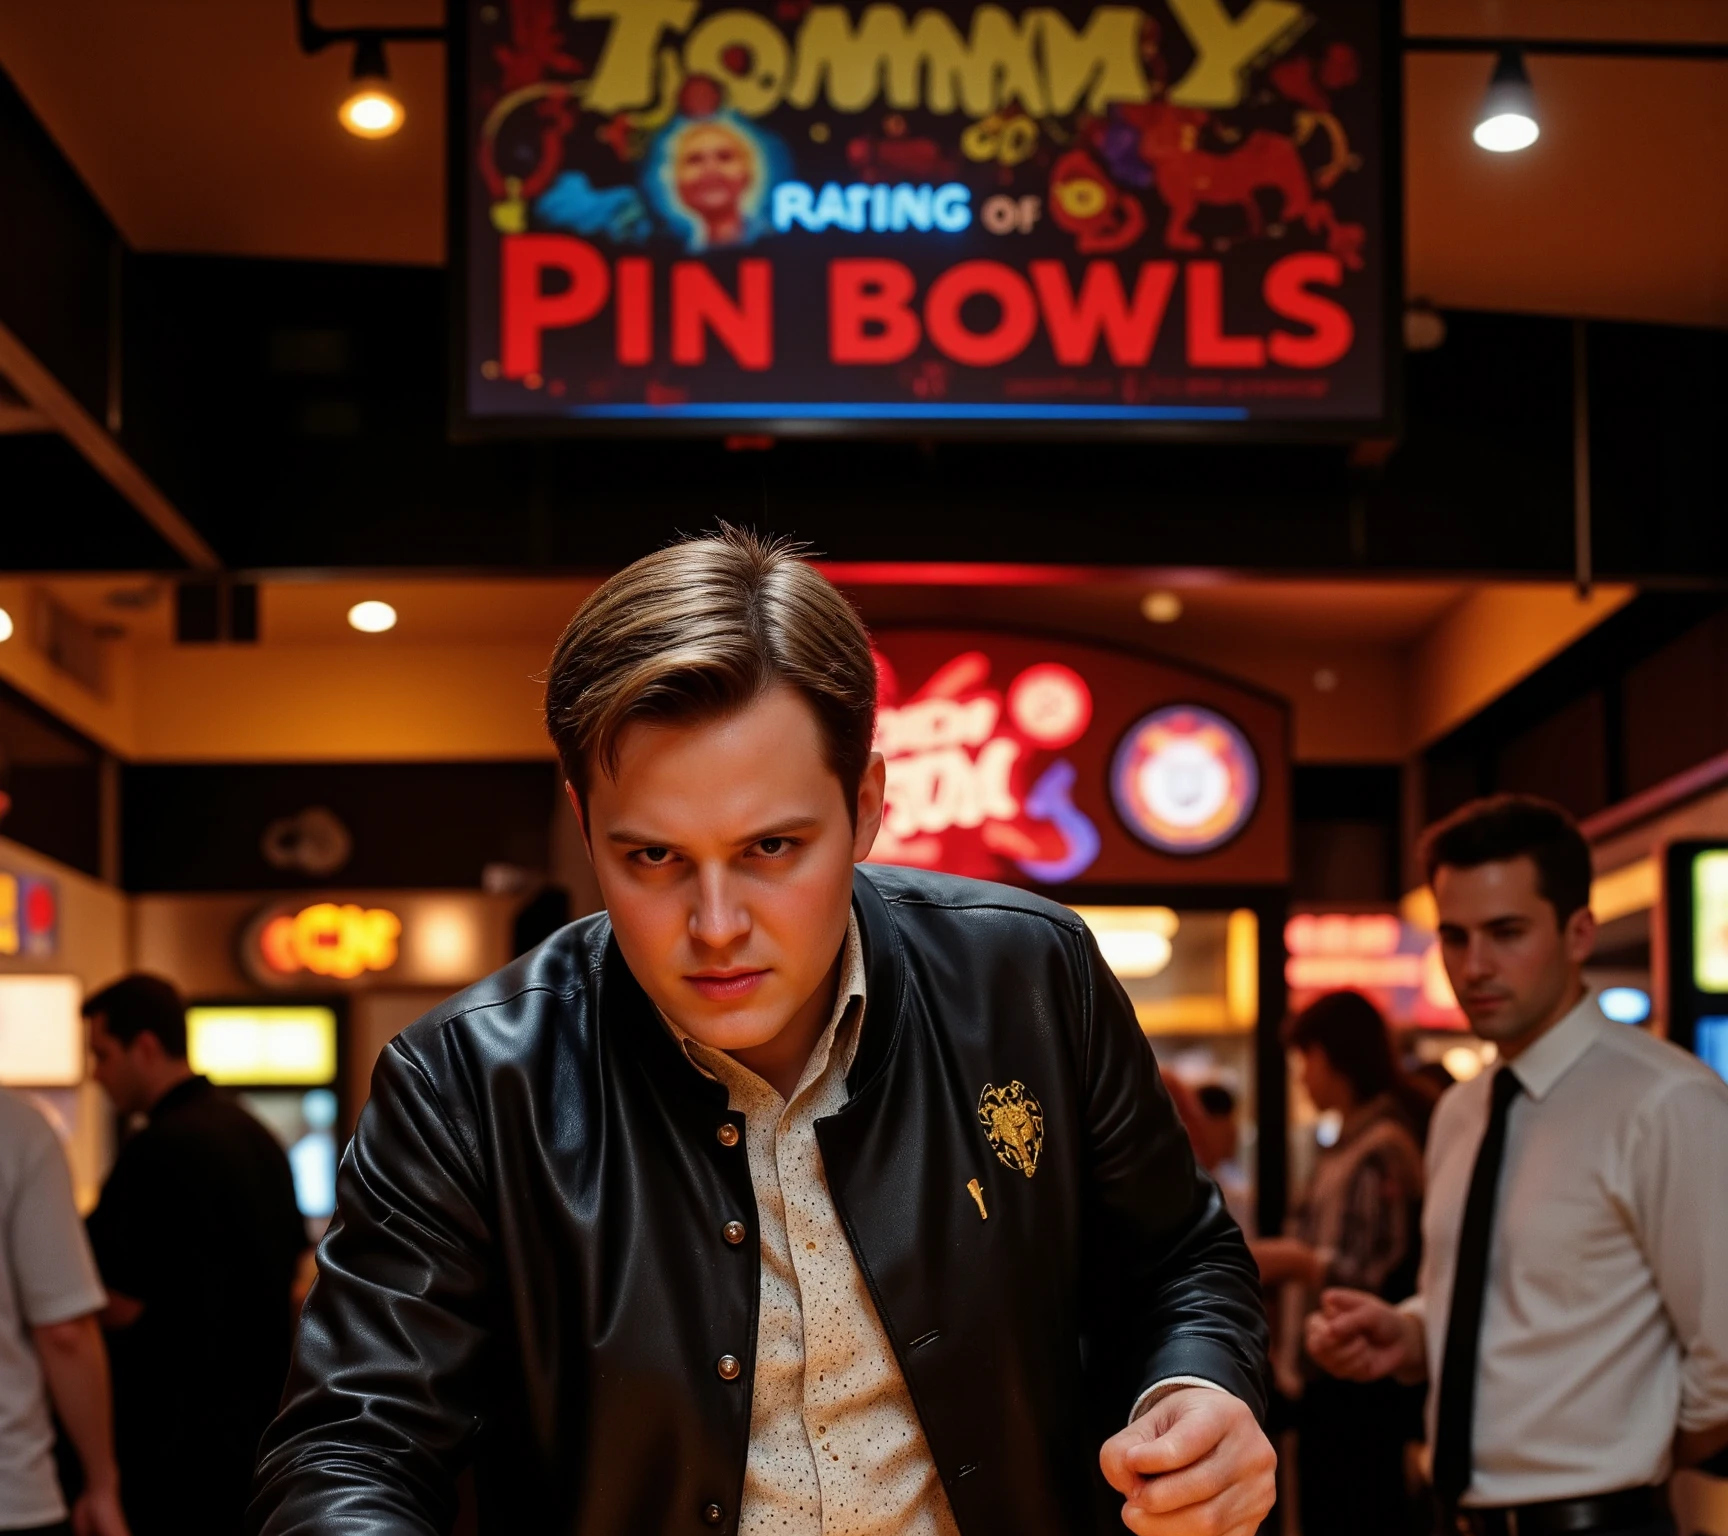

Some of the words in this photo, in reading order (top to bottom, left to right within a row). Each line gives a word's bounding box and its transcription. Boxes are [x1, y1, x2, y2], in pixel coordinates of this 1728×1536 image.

[770, 182, 972, 233] RATING
[981, 195, 1040, 234] OF
[501, 233, 773, 379] PIN
[829, 254, 1353, 368] BOWLS
